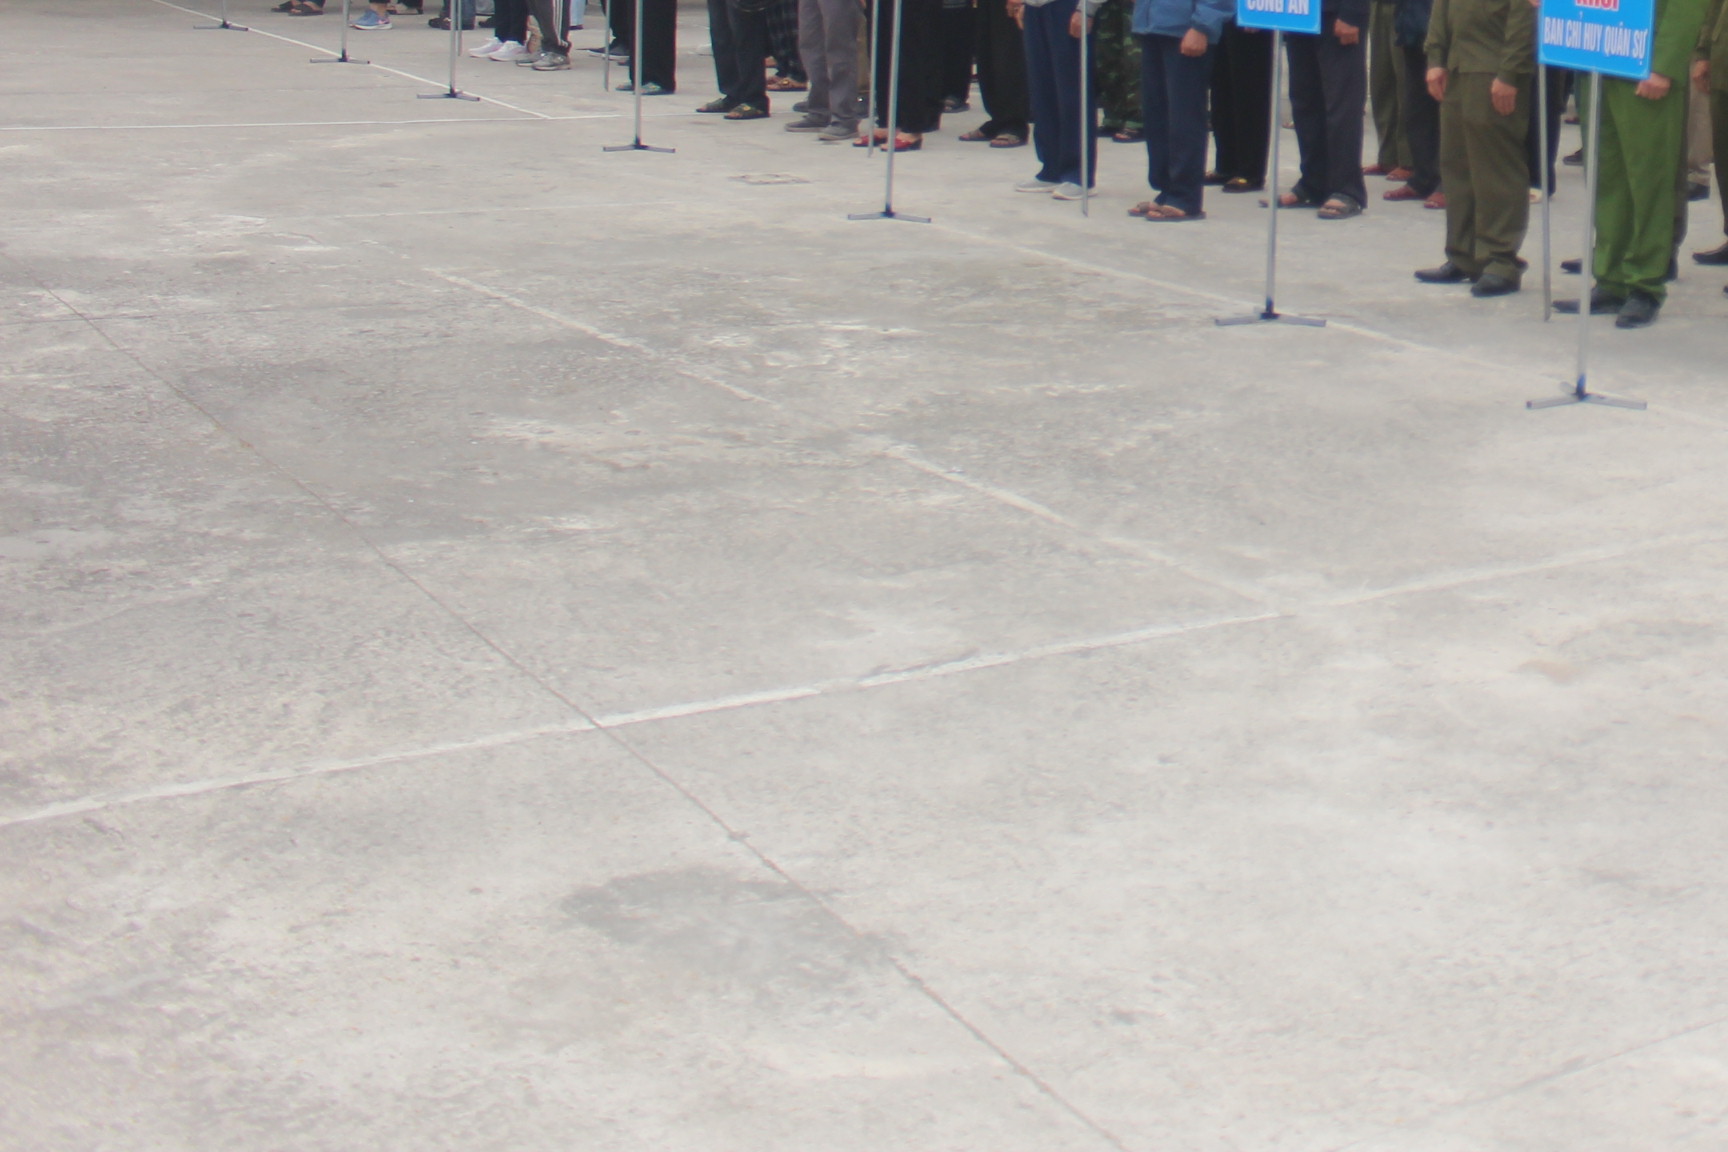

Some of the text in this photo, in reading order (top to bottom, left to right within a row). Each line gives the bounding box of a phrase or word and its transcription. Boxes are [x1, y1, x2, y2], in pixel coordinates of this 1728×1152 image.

[1544, 10, 1648, 65] BAN CHỈ HUY QUÂN SỰ
